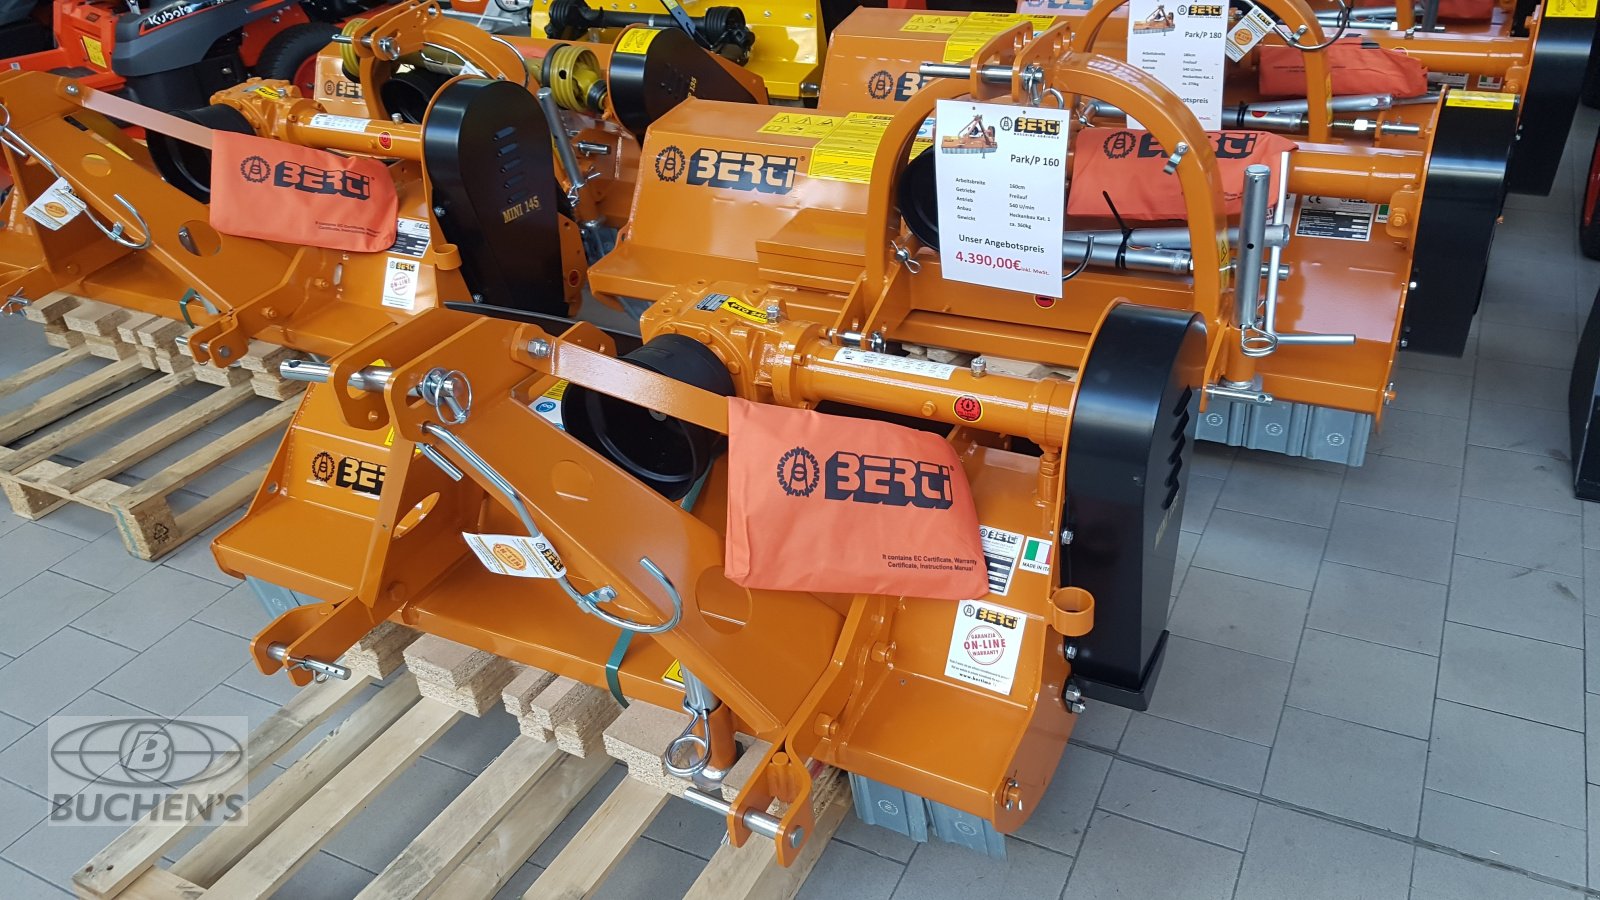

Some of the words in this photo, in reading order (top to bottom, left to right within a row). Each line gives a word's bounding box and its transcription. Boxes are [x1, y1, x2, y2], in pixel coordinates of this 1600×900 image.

[147, 5, 193, 25] Kubota
[1185, 31, 1208, 39] Park/P
[1182, 97, 1209, 105] otspreis
[1010, 154, 1041, 166] Park/P
[1042, 157, 1060, 168] 160
[955, 177, 986, 186] Arbeitsbreite
[955, 186, 976, 194] Getriebe
[502, 203, 523, 224] MINI
[524, 195, 540, 213] 145
[956, 214, 976, 222] Gewicht
[958, 234, 983, 244] Unser
[984, 238, 1045, 254] Angebotspreis
[955, 251, 1022, 271] 4.390,00€
[824, 451, 954, 510] BERTI
[887, 561, 919, 570] Certificate,
[920, 563, 953, 571] Instructions
[923, 556, 953, 564] Certificate,
[954, 557, 977, 566] Warranty
[970, 632, 996, 640] GARANZIA
[963, 638, 1007, 651] ON-LINE
